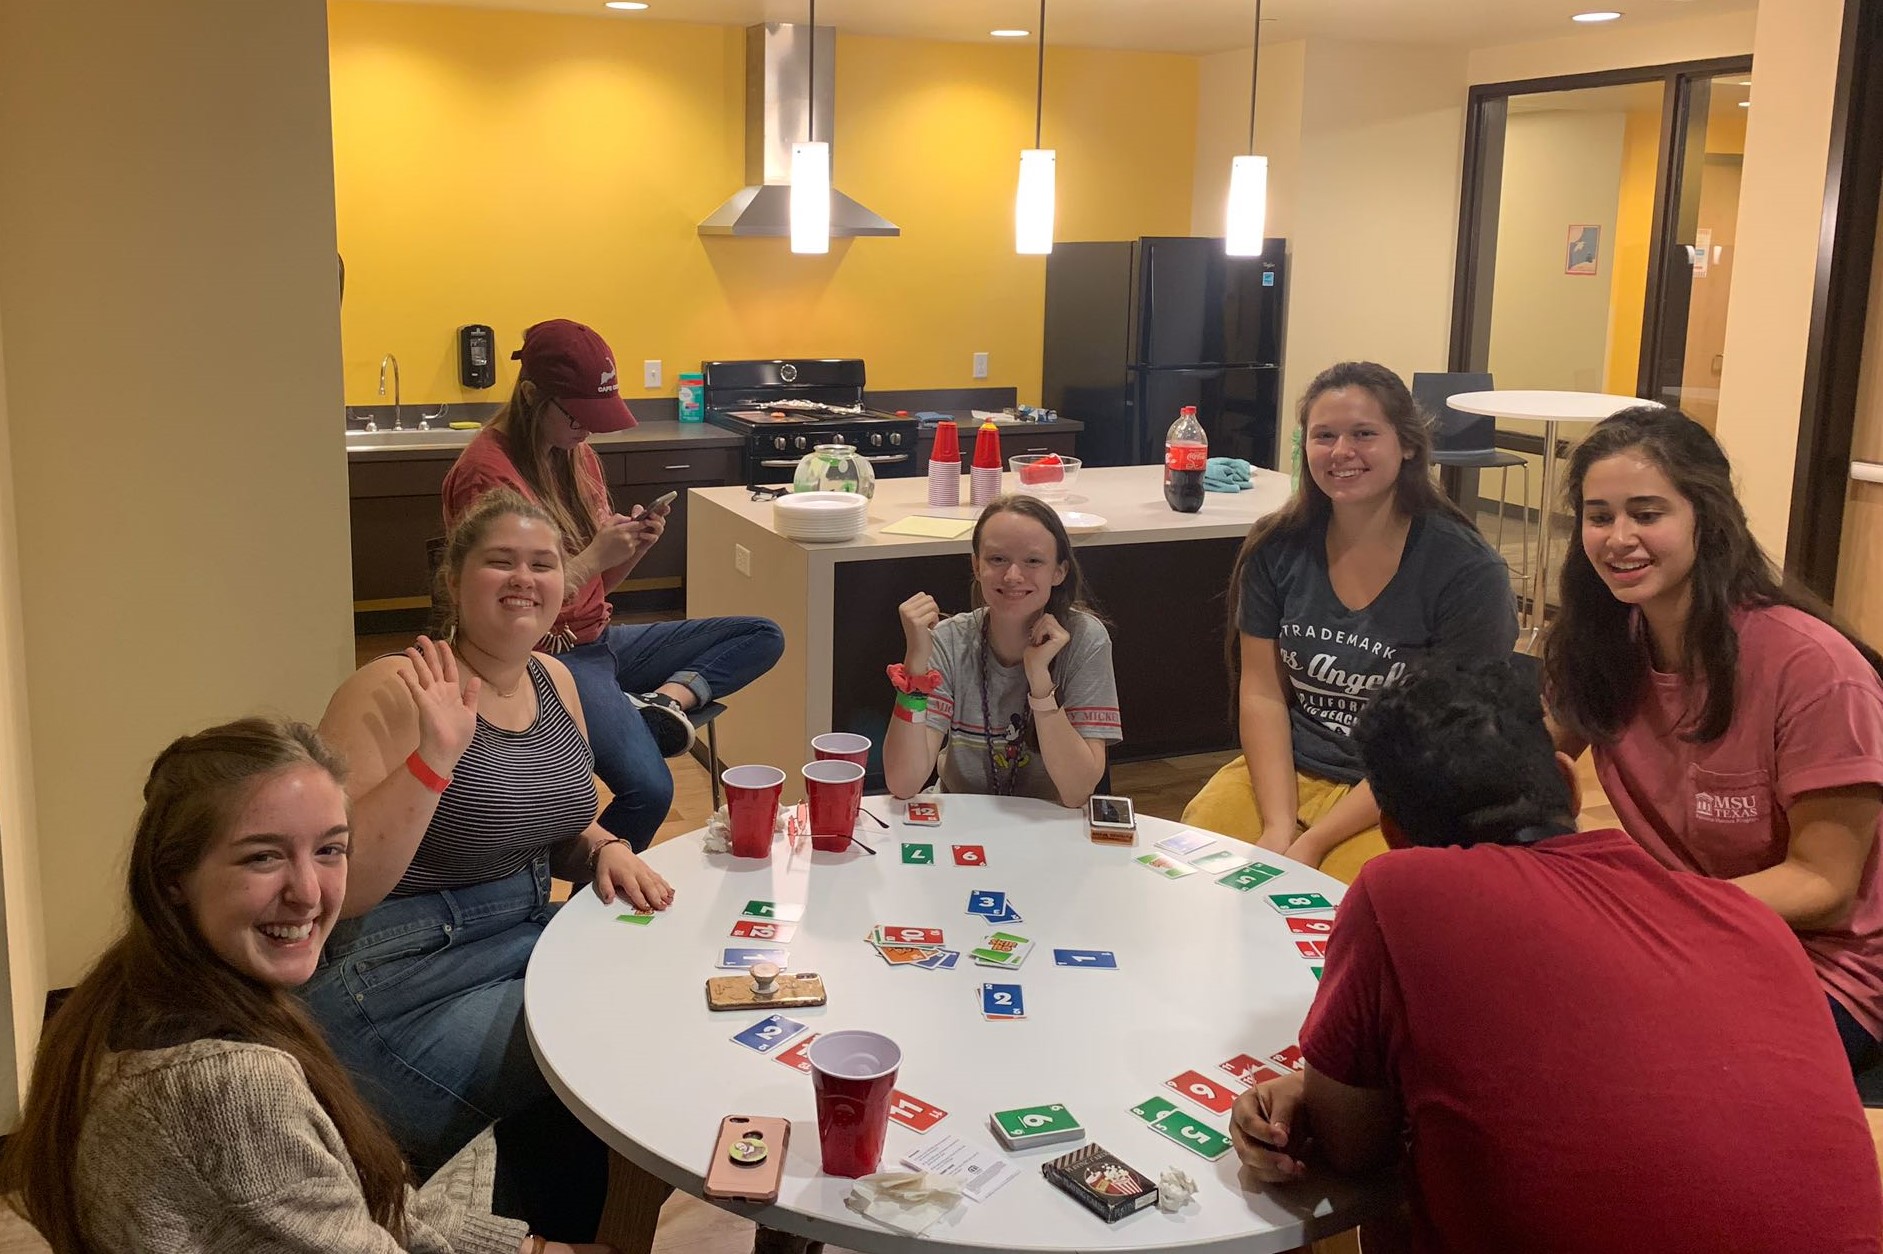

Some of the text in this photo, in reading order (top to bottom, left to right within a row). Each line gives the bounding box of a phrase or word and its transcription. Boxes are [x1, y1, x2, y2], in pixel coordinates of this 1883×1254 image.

[1282, 624, 1396, 660] TRADEMARK
[1280, 648, 1304, 670] os
[1083, 712, 1118, 721] MICKE
[1714, 795, 1756, 810] MSU
[911, 807, 936, 816] 12
[1715, 808, 1758, 818] TEXAS
[911, 850, 926, 859] 7
[978, 896, 994, 907] 3
[750, 924, 776, 938] 12
[900, 929, 924, 942] 10
[994, 992, 1012, 1006] 2
[754, 1025, 783, 1041] 2
[1190, 1083, 1216, 1100] 9
[891, 1099, 924, 1119] 11
[1180, 1126, 1212, 1144] 5
